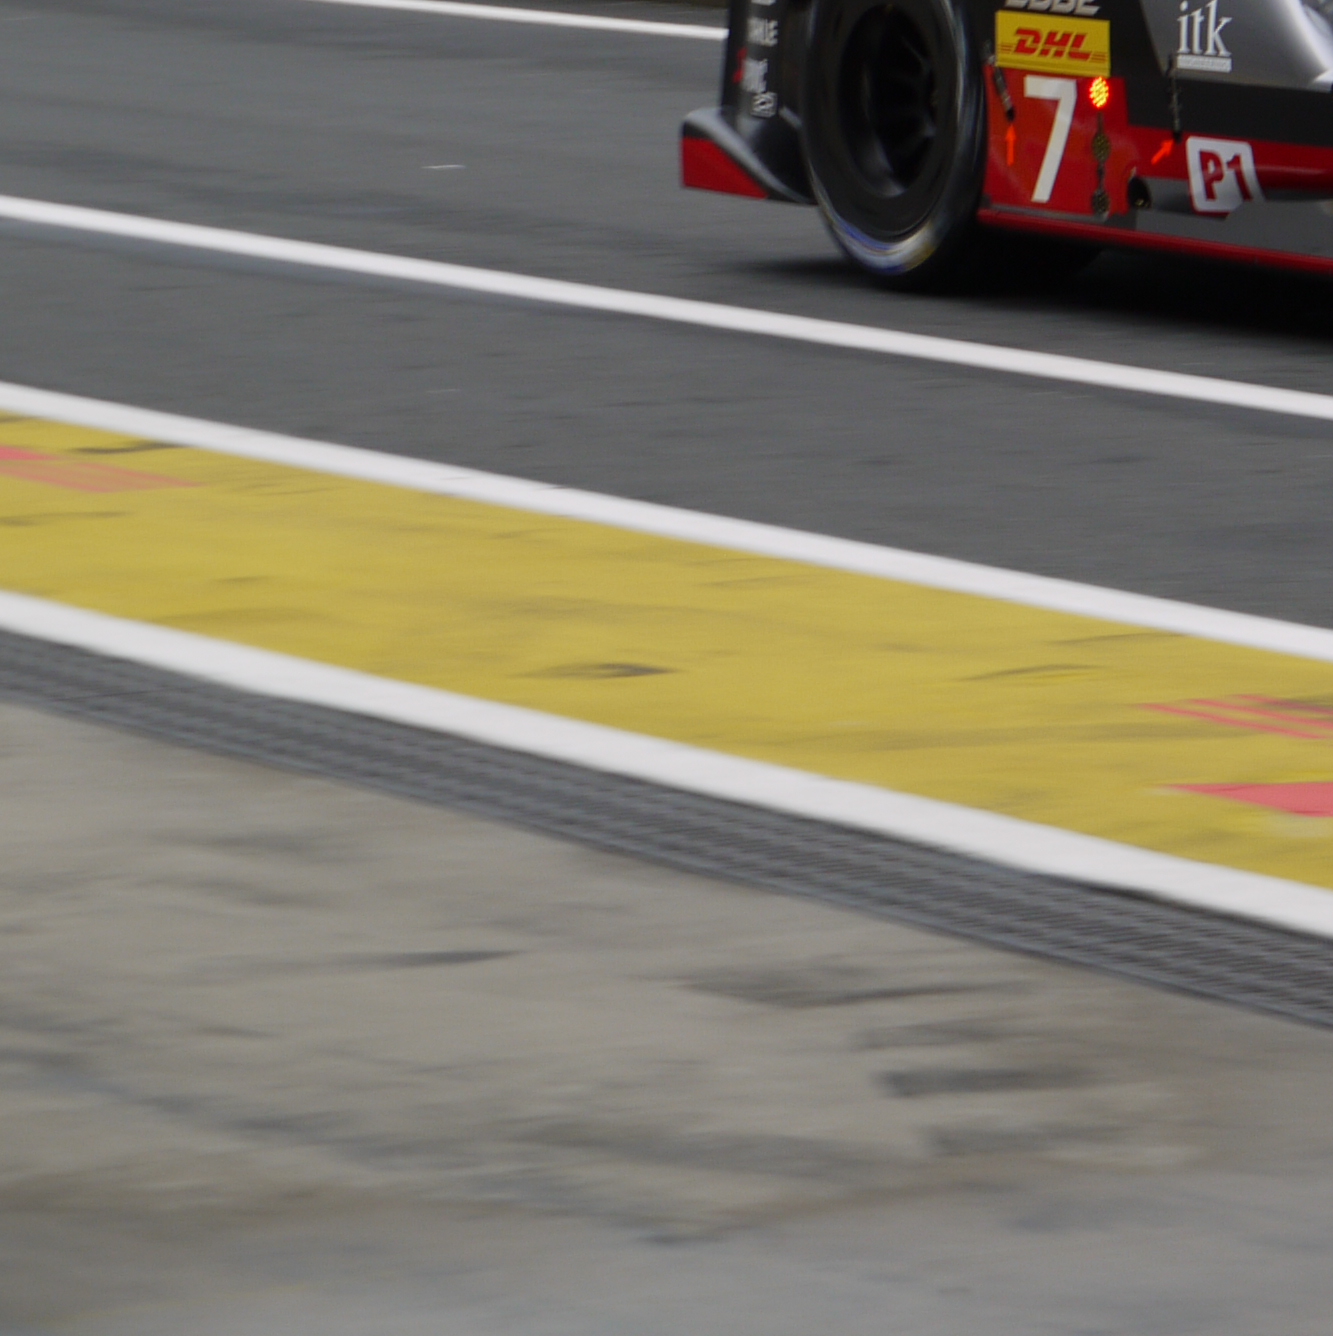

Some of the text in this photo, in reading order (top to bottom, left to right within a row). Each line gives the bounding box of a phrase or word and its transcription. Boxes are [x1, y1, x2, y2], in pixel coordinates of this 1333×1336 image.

[1013, 28, 1094, 62] DHL
[1024, 75, 1077, 203] 7
[1199, 150, 1254, 203] P1
